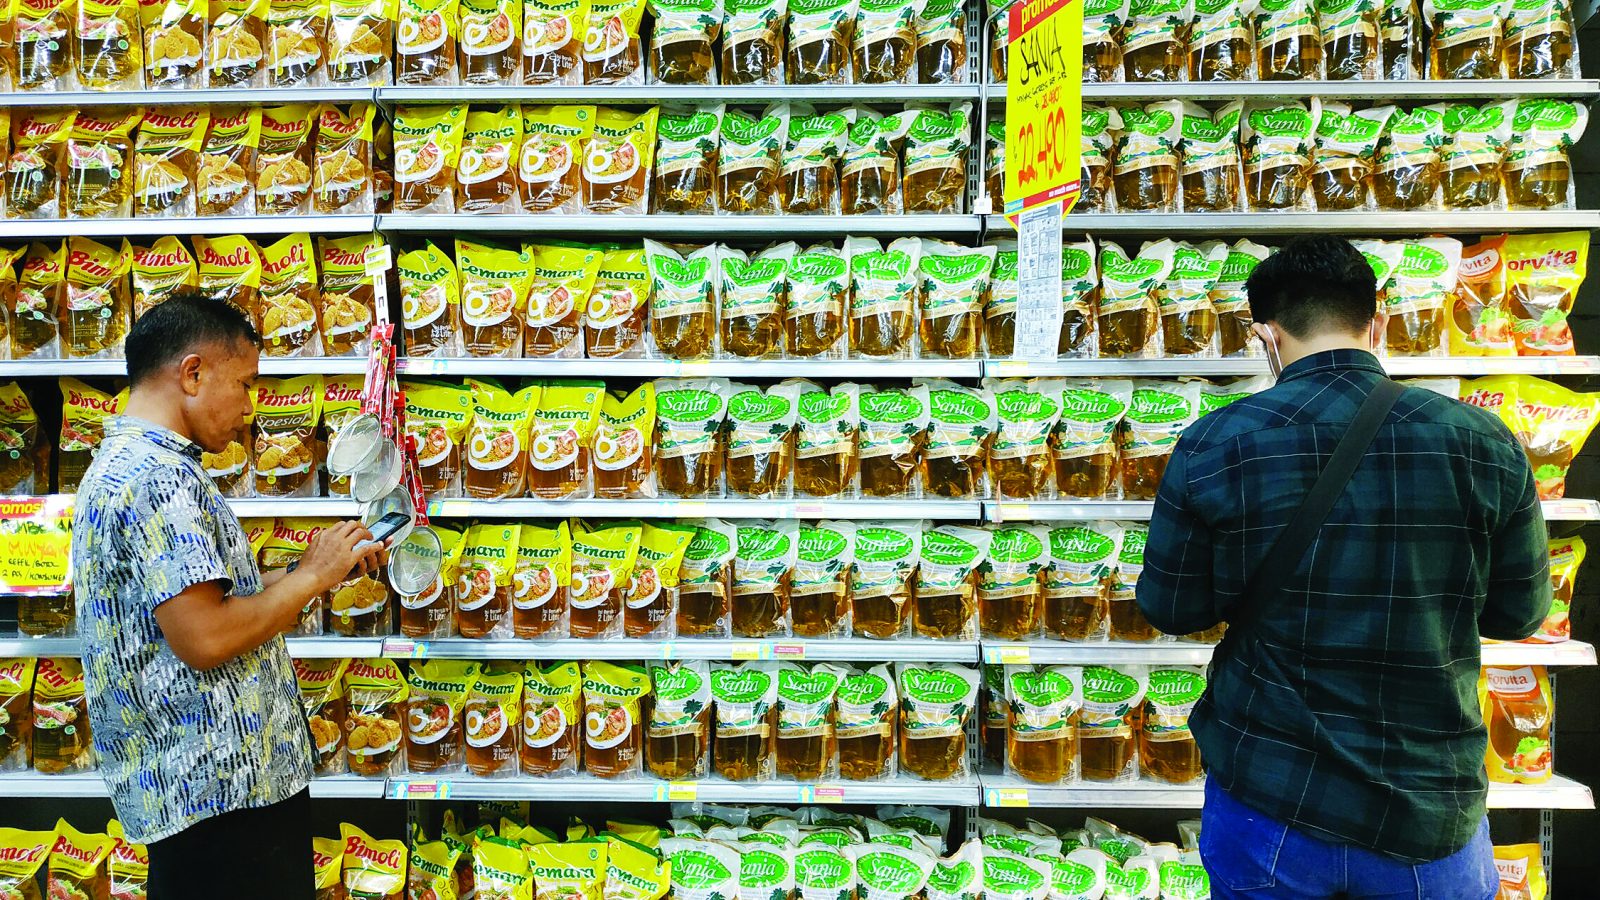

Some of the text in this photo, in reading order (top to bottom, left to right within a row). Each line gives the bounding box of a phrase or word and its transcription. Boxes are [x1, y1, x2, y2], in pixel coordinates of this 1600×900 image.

[1020, 16, 1067, 86] SANIA
[144, 107, 200, 128] imoli
[392, 117, 452, 135] Cemara
[593, 121, 645, 137] emara
[261, 242, 306, 274] imoli
[461, 256, 528, 279] Cemara
[793, 256, 838, 276] Sania
[931, 257, 977, 276] Sania
[1062, 254, 1081, 270] nia
[1221, 258, 1249, 275] nia
[1399, 252, 1433, 271] ania
[1507, 248, 1578, 271] orvita
[397, 266, 449, 281] emara
[535, 266, 584, 281] emara
[597, 269, 646, 281] mara
[257, 384, 315, 407] Bimoli
[662, 395, 709, 413] Sania
[931, 395, 975, 415] Sania
[1062, 394, 1110, 414] Sania
[406, 397, 465, 422] emara
[472, 397, 526, 421] emara
[535, 408, 590, 421] emara
[600, 406, 646, 425] emara
[1517, 400, 1590, 421] orvita
[257, 413, 308, 427] Spesial
[572, 541, 625, 560] emara
[690, 532, 720, 551] ania
[799, 534, 834, 551] ania
[461, 545, 506, 559] emara
[485, 614, 489, 622] 2
[542, 613, 546, 621] 2
[598, 614, 602, 622] 2
[648, 614, 652, 622] 2
[473, 679, 515, 695] emara
[716, 673, 759, 692] Sania
[783, 675, 827, 693] Sania
[911, 674, 956, 694] Sania
[1021, 675, 1059, 695] Sania
[1488, 673, 1528, 685] Forvita
[0, 844, 48, 862] moli
[52, 835, 103, 863] Bimol
[110, 837, 149, 864] Bimo
[345, 836, 401, 868] Bimoli
[411, 848, 449, 878] emara
[674, 857, 716, 878] Sania
[741, 858, 776, 876] ania
[800, 858, 842, 878] Sania
[868, 858, 912, 882] Sania
[1497, 863, 1523, 875] vita
[1051, 866, 1084, 885] ania
[1105, 869, 1138, 888] ania
